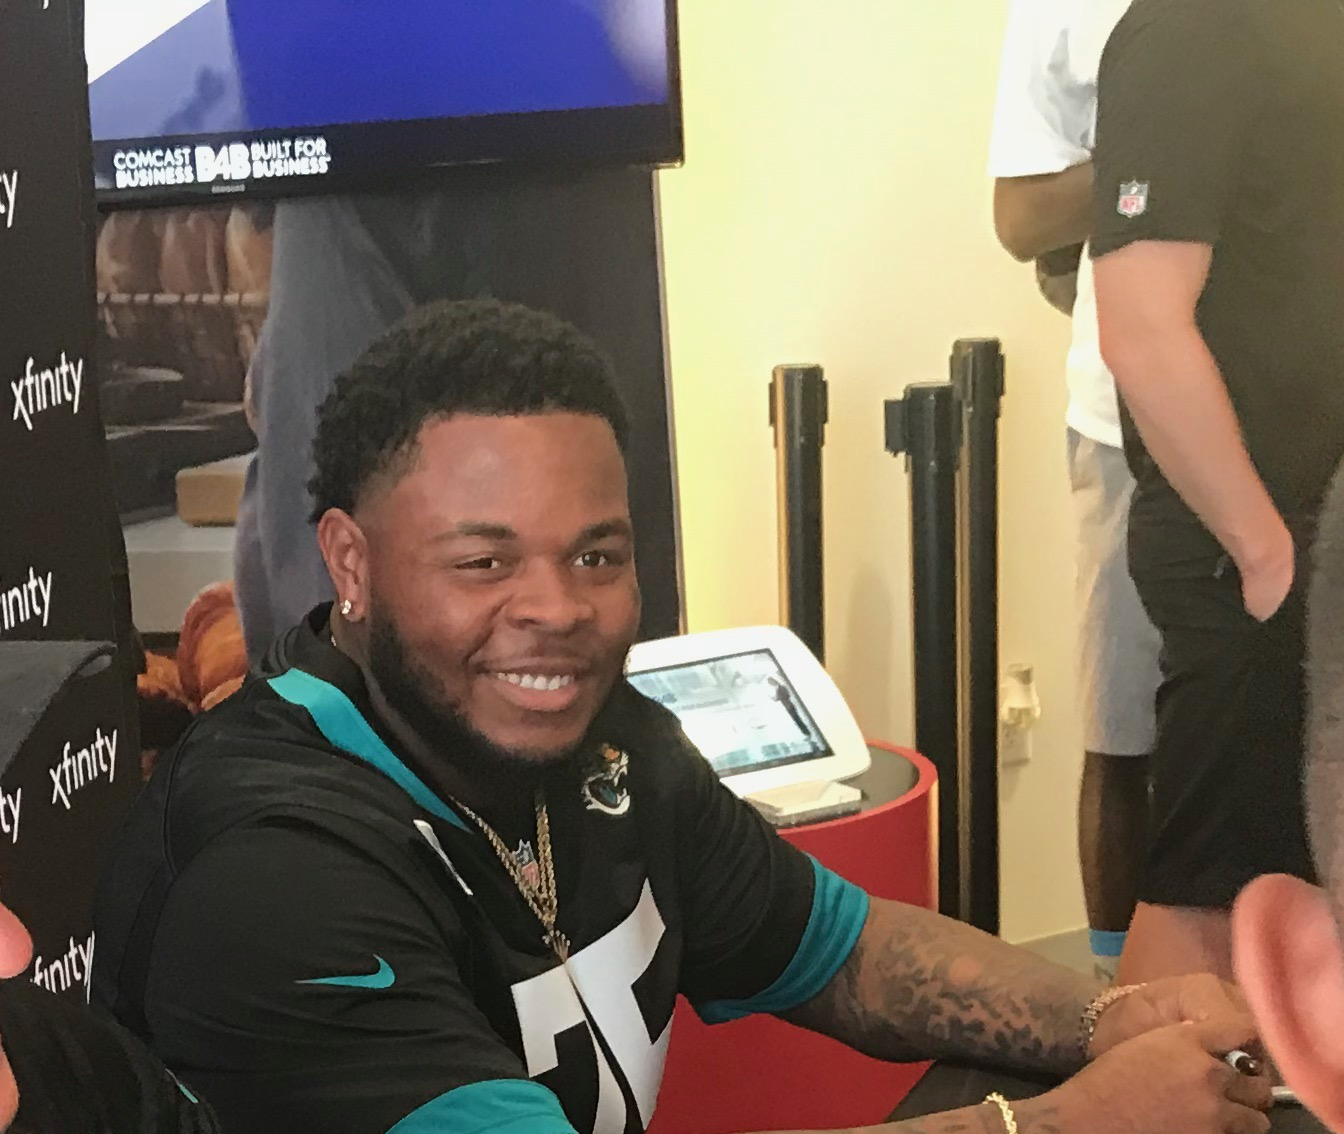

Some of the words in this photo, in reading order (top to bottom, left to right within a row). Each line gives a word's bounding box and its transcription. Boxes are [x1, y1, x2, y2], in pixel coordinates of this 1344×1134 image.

[113, 146, 192, 170] COMCAST
[194, 142, 252, 183] B4B
[251, 139, 292, 161] BUILT
[294, 136, 327, 159] FOR
[115, 165, 195, 188] BUSINESS
[252, 156, 330, 179] BUSINESS
[11, 352, 83, 430] xfinity
[50, 728, 117, 809] xfinity
[32, 931, 95, 1003] finity
